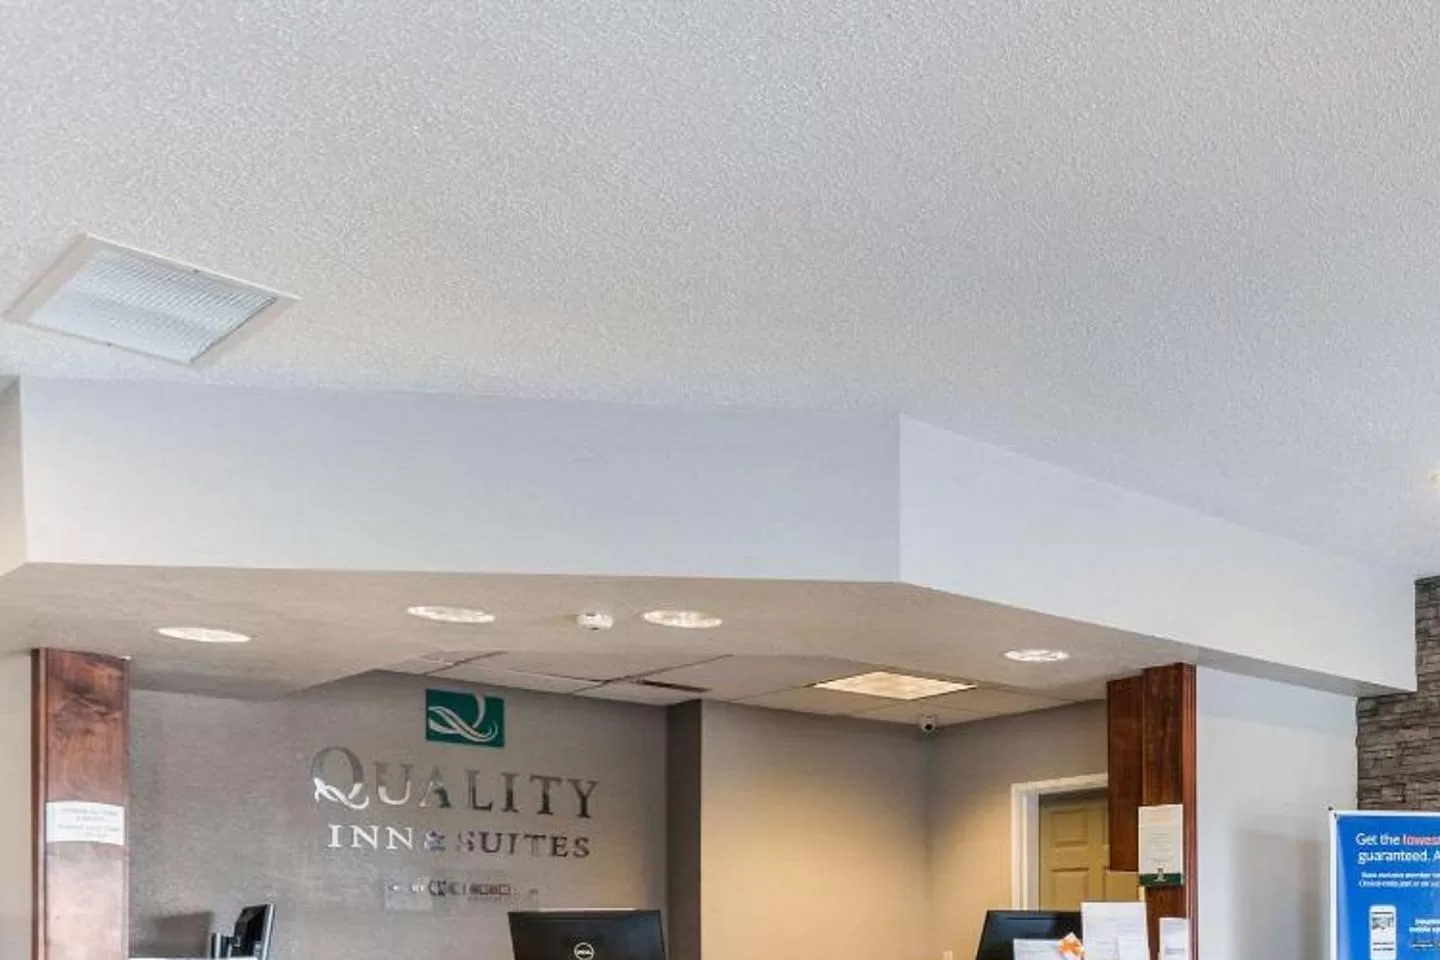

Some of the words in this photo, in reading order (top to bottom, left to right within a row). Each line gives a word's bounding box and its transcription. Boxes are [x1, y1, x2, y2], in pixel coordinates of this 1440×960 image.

[311, 746, 600, 819] QUALITY
[327, 823, 413, 849] INN
[423, 830, 446, 851] &
[458, 830, 591, 858] SUITES
[1355, 832, 1378, 846] Get
[1380, 832, 1400, 846] the
